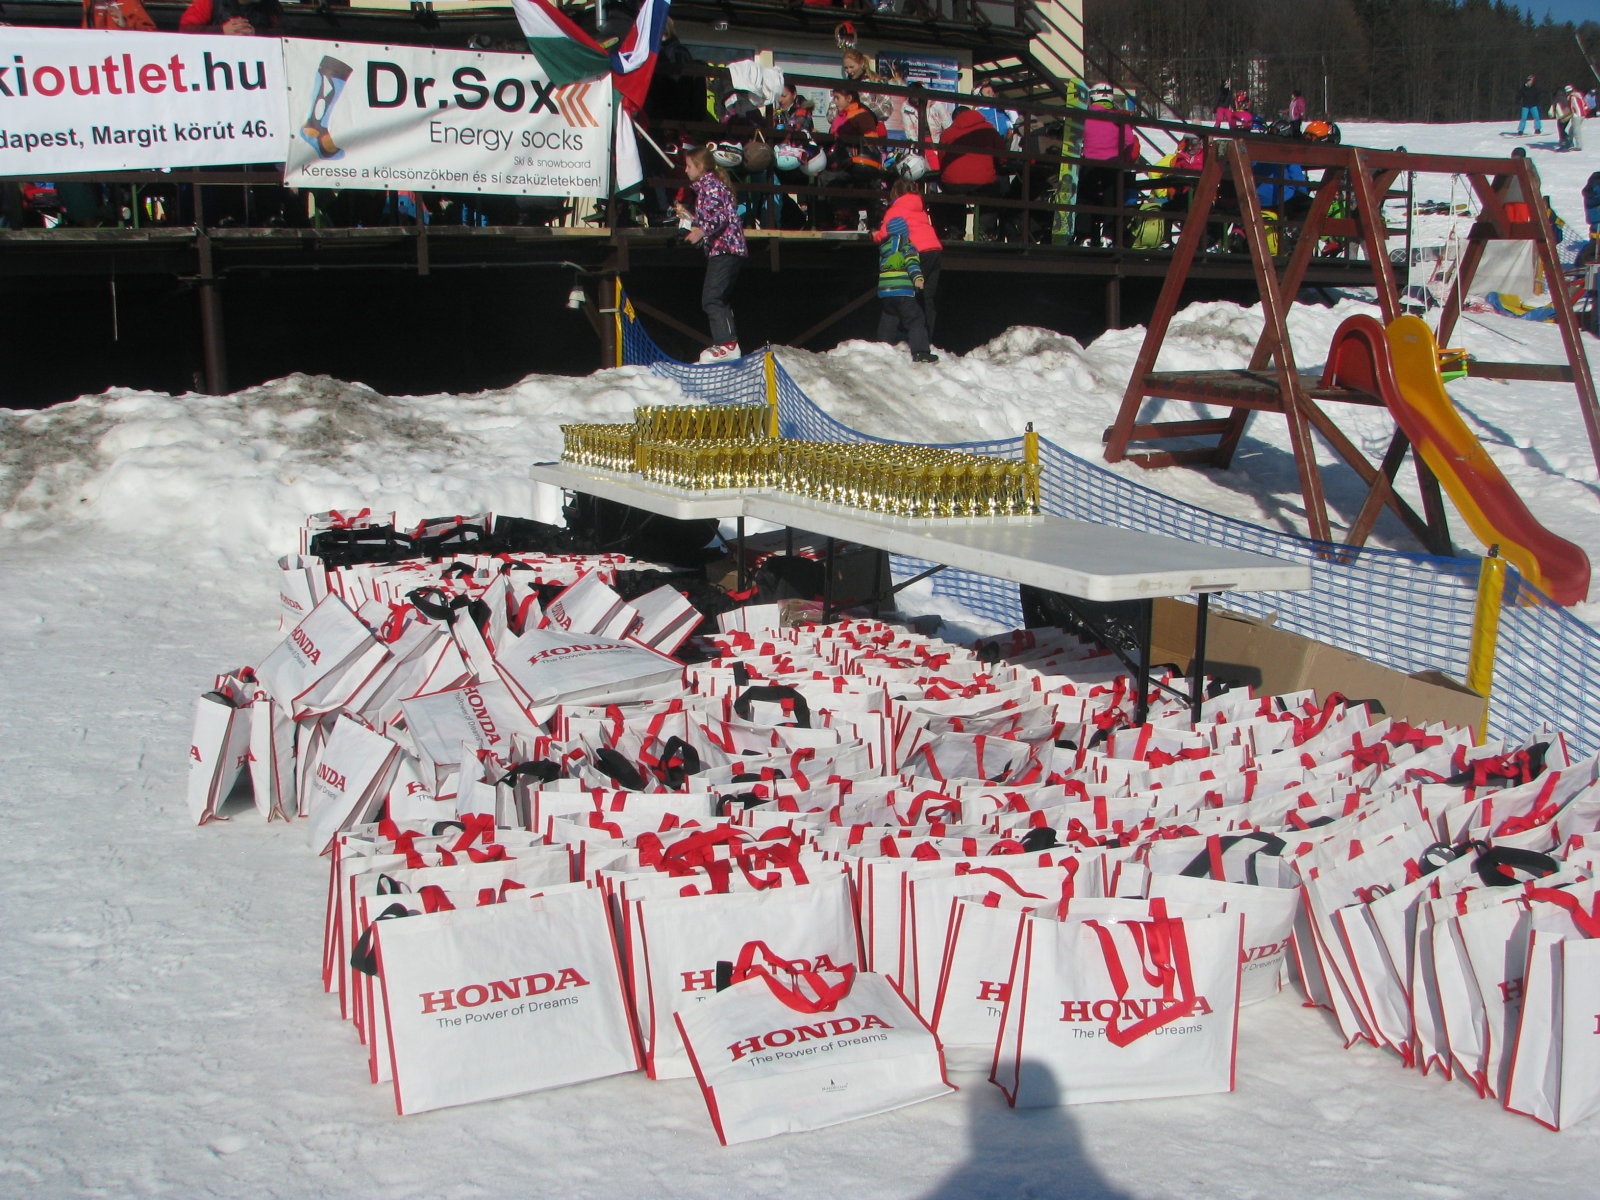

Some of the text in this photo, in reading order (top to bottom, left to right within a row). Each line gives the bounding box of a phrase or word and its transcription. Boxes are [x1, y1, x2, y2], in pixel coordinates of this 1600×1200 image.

[366, 59, 561, 115] Dr.Sox
[92, 124, 168, 149] Margit
[174, 120, 235, 142] körút
[241, 120, 274, 139] 46.
[430, 121, 583, 151] Energy socks
[301, 164, 357, 177] Keresse
[362, 169, 370, 178] a
[473, 171, 487, 183] és
[505, 174, 601, 188] szaküzletekben!
[514, 156, 591, 169] Ski & snowboard
[528, 643, 637, 666] HONDA
[463, 686, 501, 746] HONDA
[418, 967, 590, 1014] HONDA
[437, 995, 579, 1028] The Power of Dreams
[727, 1014, 894, 1062] HONDA
[1072, 1028, 1094, 1039] The
[1155, 1024, 1202, 1036] Dreams
[748, 1033, 888, 1068] The Power of Dreams
